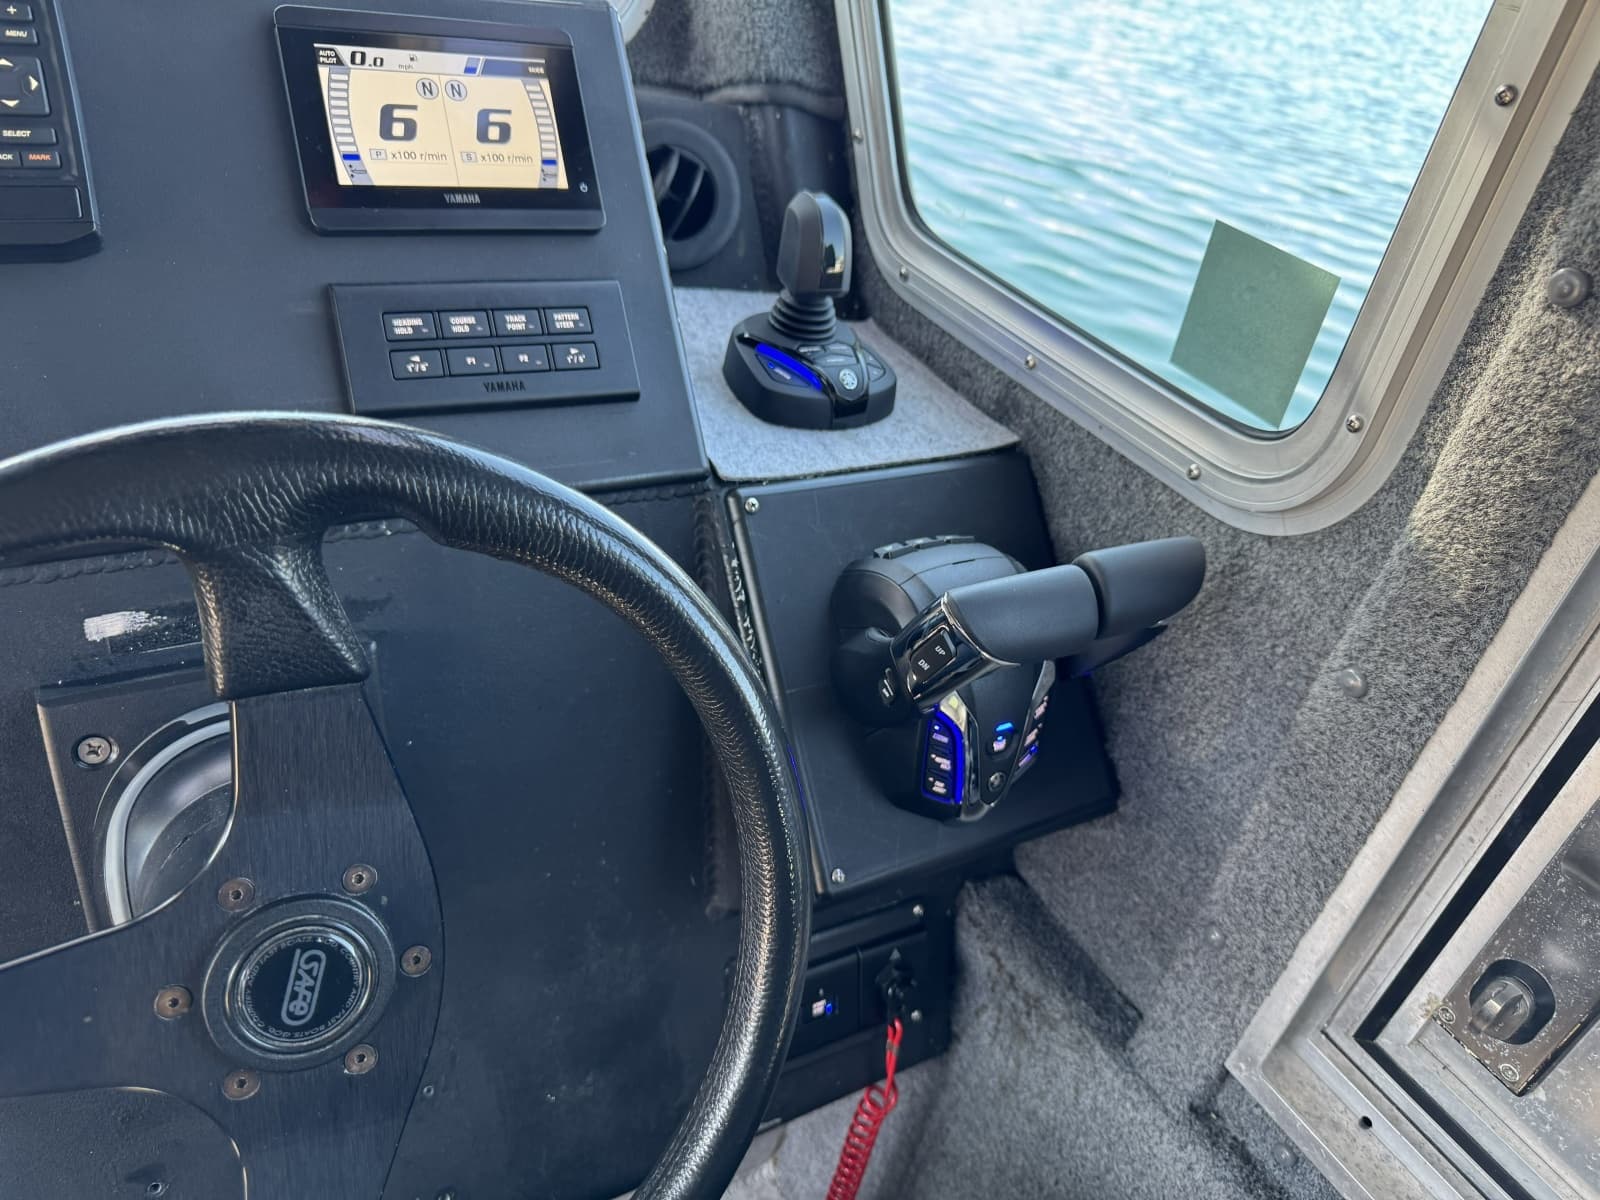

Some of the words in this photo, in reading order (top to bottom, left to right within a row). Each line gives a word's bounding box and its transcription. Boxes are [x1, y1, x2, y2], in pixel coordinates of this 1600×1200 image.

[5, 29, 28, 38] MENU
[318, 49, 336, 57] AUTO
[319, 56, 337, 64] PILOT
[350, 50, 384, 67] 0.0
[398, 63, 414, 71] mph
[421, 81, 434, 97] N
[449, 83, 462, 98] N
[379, 104, 418, 142] 6
[476, 108, 512, 145] 6
[28, 153, 51, 161] MARK
[391, 150, 417, 160] x100
[420, 150, 447, 161] r/min
[480, 153, 506, 163] x100
[507, 153, 533, 164] r/min
[444, 193, 481, 204] YAMAHA
[449, 316, 476, 325] COURSE
[504, 314, 526, 322] TRACK
[552, 312, 580, 321] PATTERN
[391, 318, 423, 327] HEADING
[505, 323, 526, 331] POINT
[555, 321, 575, 329] STEER
[393, 327, 413, 336] HOLD
[451, 325, 470, 333] HOLD
[483, 381, 526, 392] YAMAHA
[935, 645, 946, 656] UP
[917, 659, 930, 671] DN
